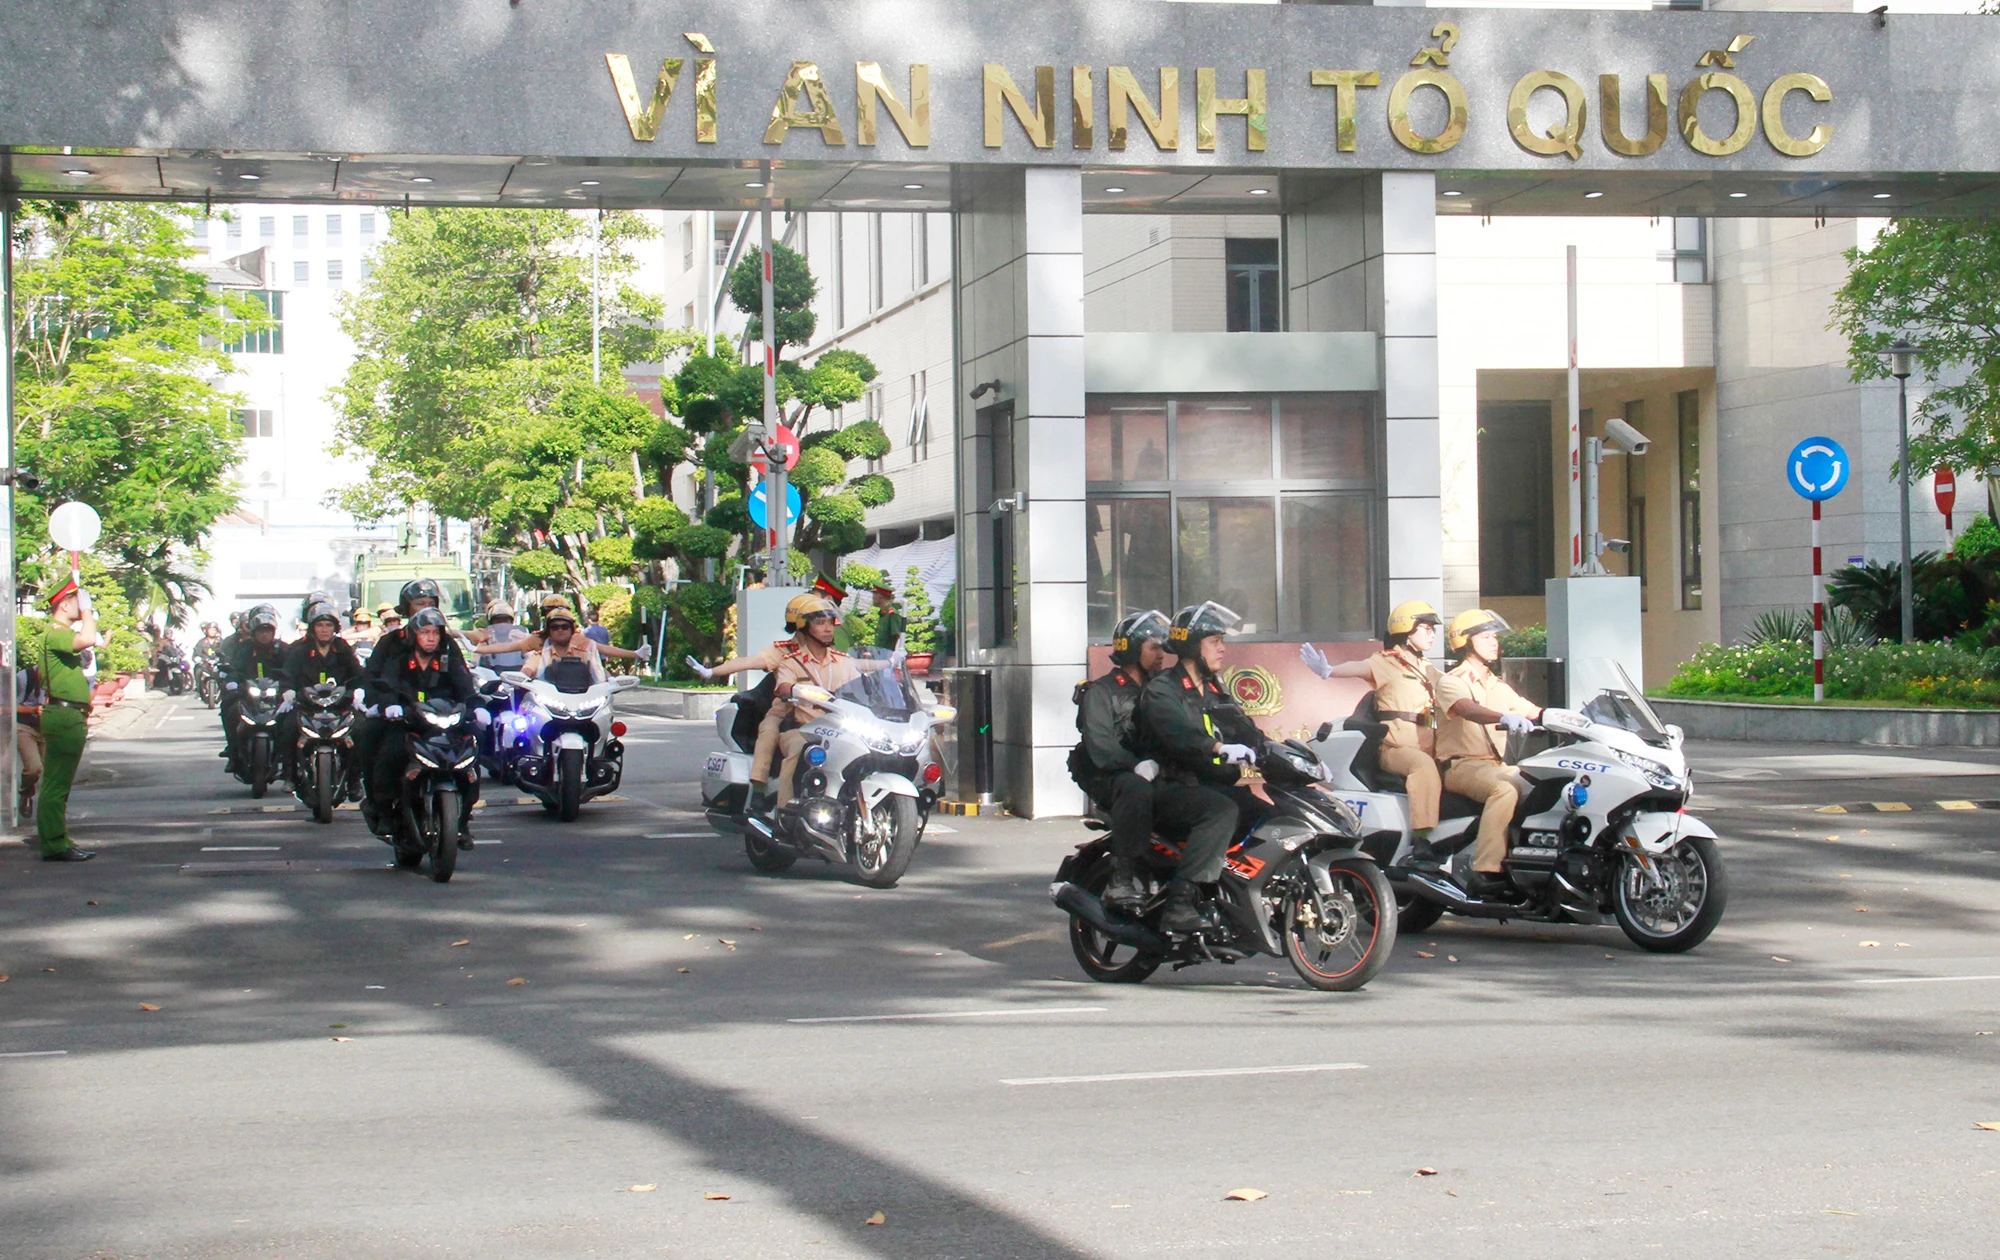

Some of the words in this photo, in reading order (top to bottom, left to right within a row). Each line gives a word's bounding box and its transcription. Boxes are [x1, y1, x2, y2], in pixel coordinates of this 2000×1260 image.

[605, 32, 718, 144] VÌ
[763, 60, 930, 147] AN
[982, 63, 1267, 151] NINH
[1311, 22, 1469, 155] TỔ
[1507, 33, 1834, 161] QUỐC
[814, 727, 843, 738] CSGT
